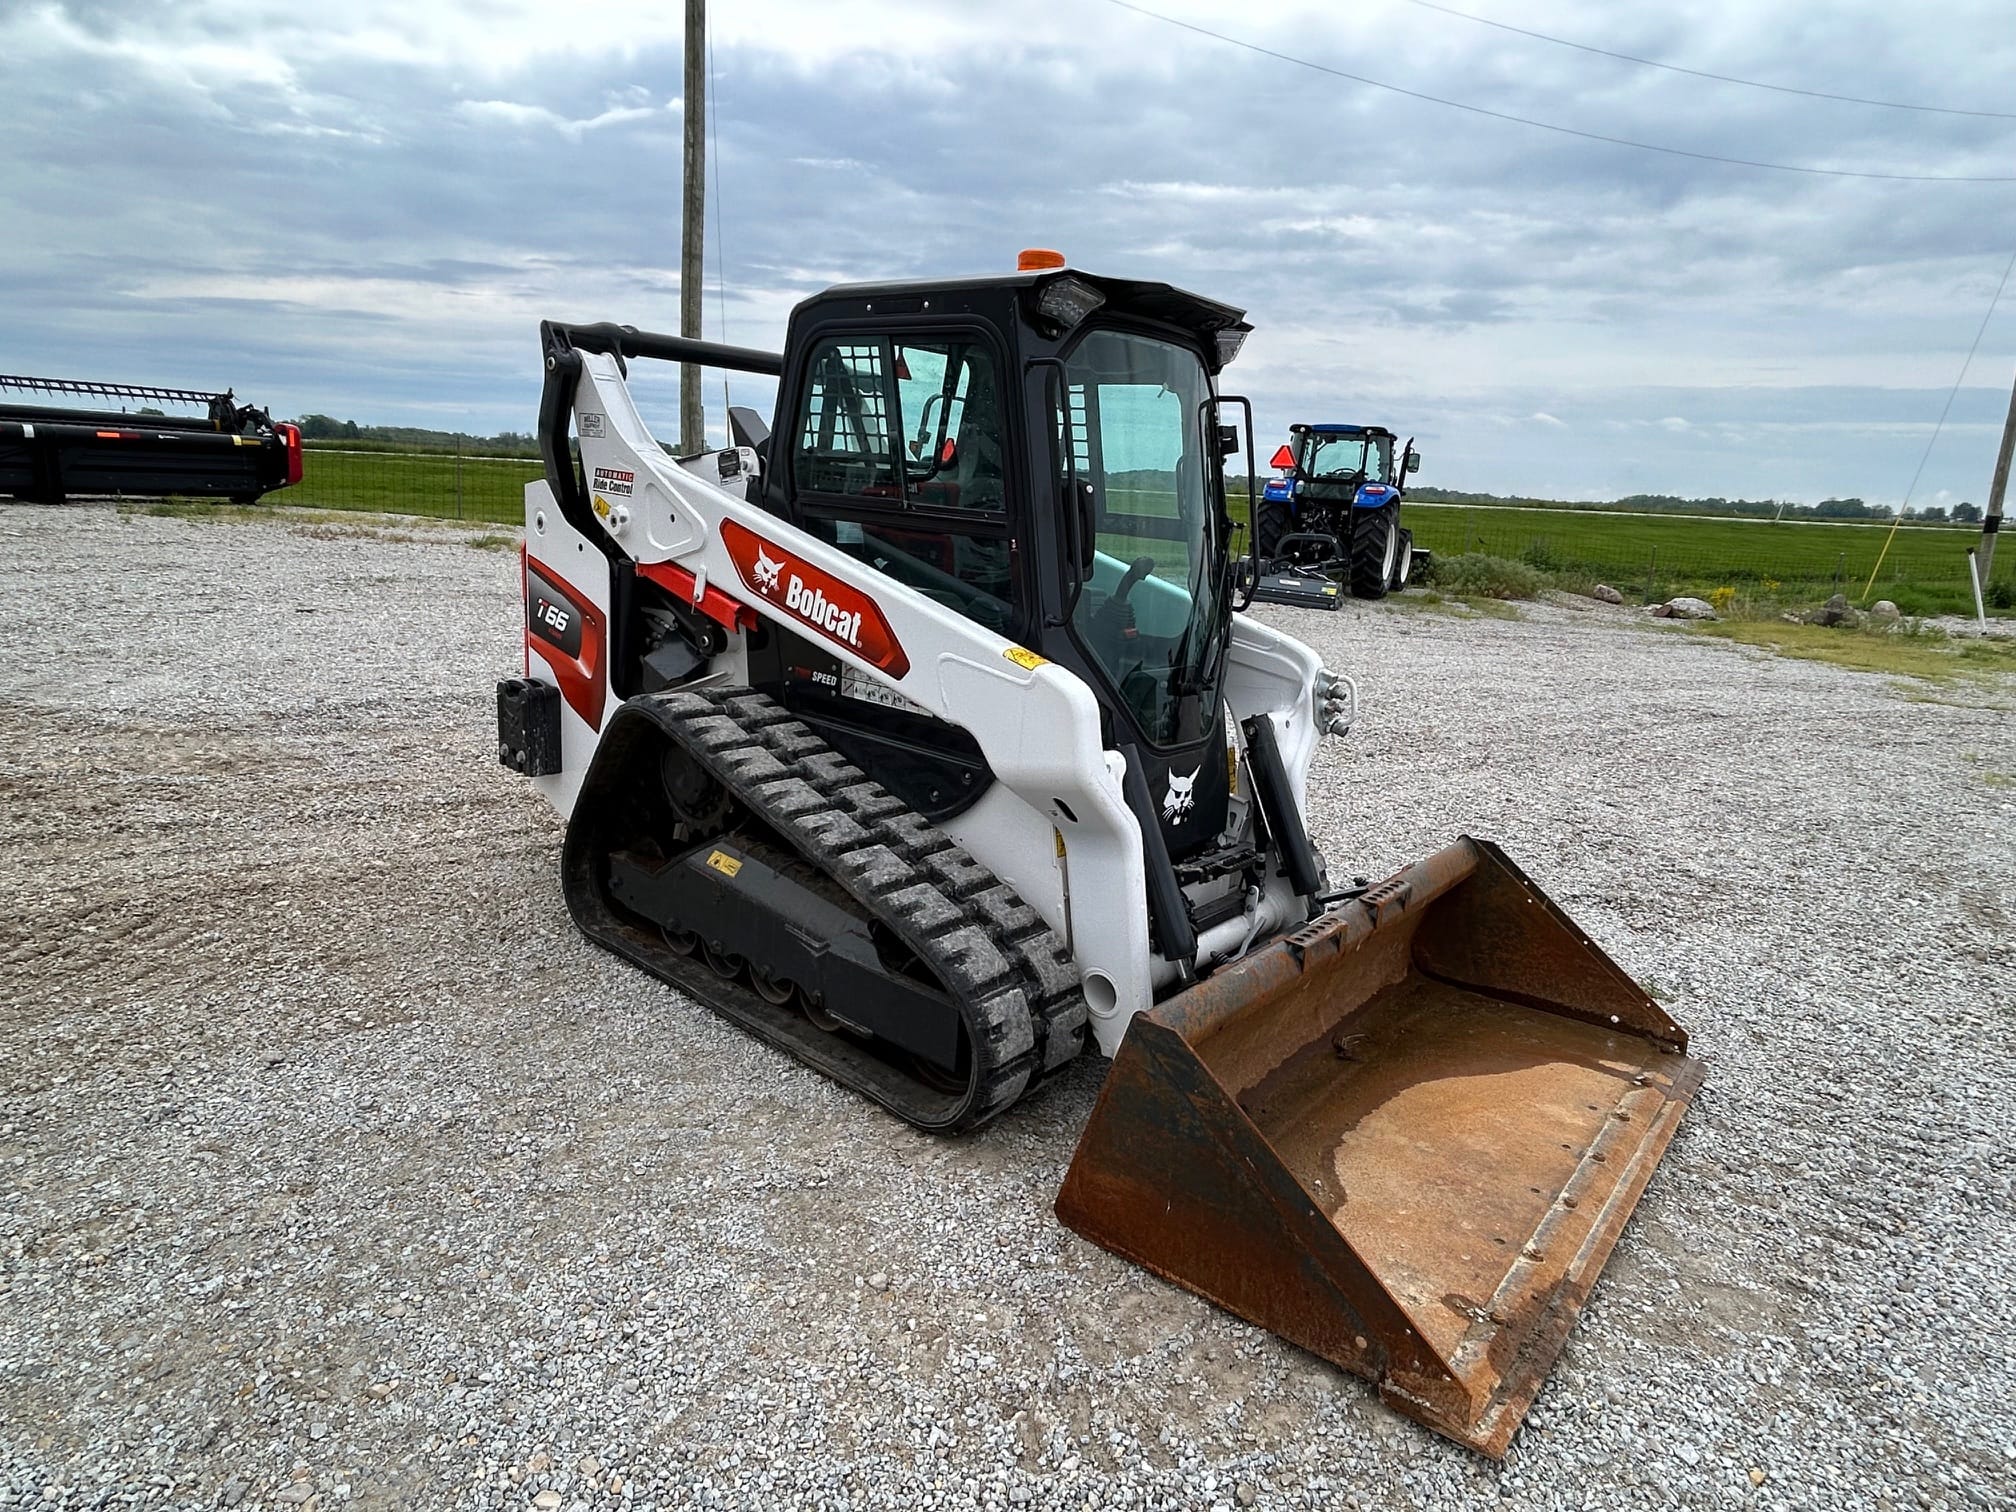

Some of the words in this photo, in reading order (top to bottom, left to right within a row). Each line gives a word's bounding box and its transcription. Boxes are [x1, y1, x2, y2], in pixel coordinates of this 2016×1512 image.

[596, 468, 633, 482] AUTOMATIC
[593, 478, 608, 490] Ride
[609, 481, 634, 495] Control
[537, 598, 570, 632] T66
[786, 573, 862, 646] Bobcat
[811, 671, 838, 687] SPEED
